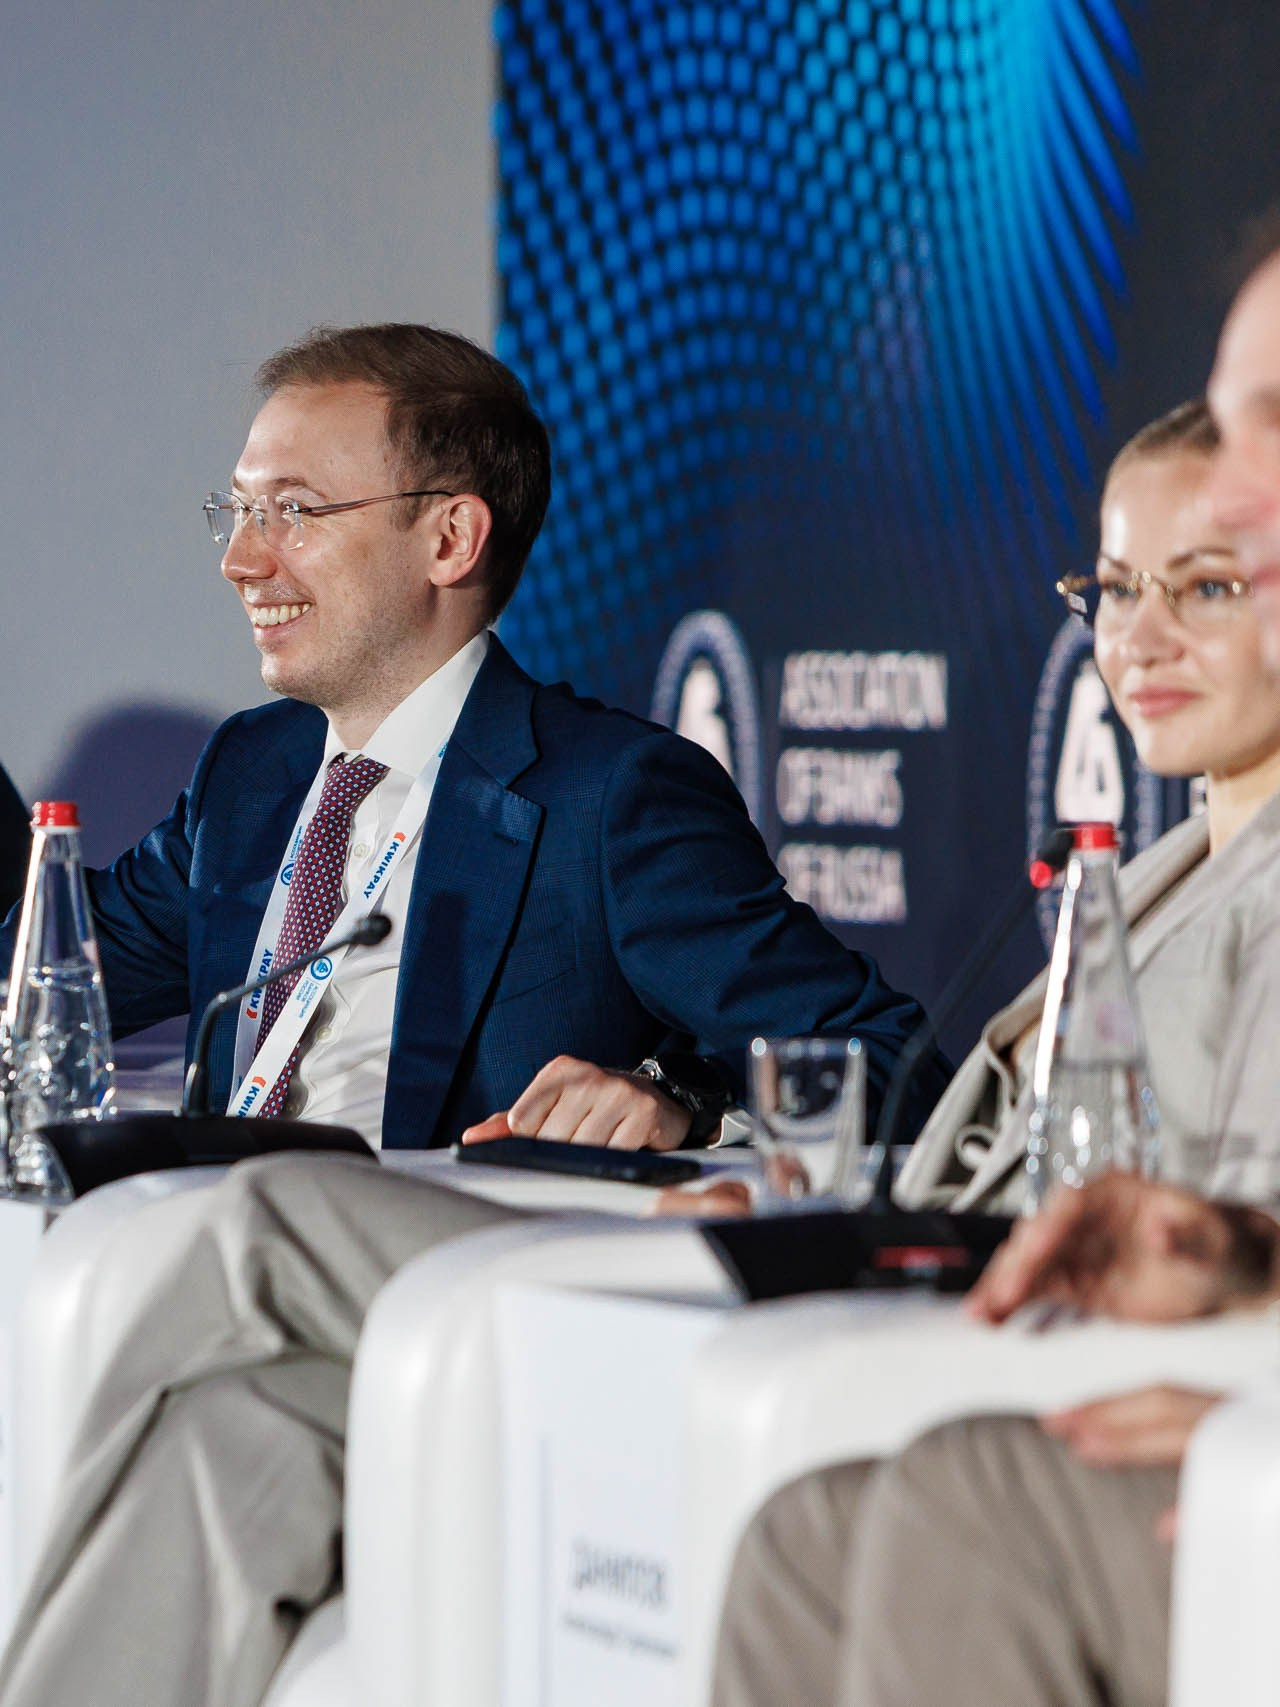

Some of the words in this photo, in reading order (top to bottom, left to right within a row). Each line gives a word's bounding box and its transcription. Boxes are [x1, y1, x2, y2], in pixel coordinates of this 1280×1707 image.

[779, 650, 948, 731] ASSOCIATION
[363, 841, 400, 899] KWIKPAY
[250, 949, 273, 1009] KWKPAY
